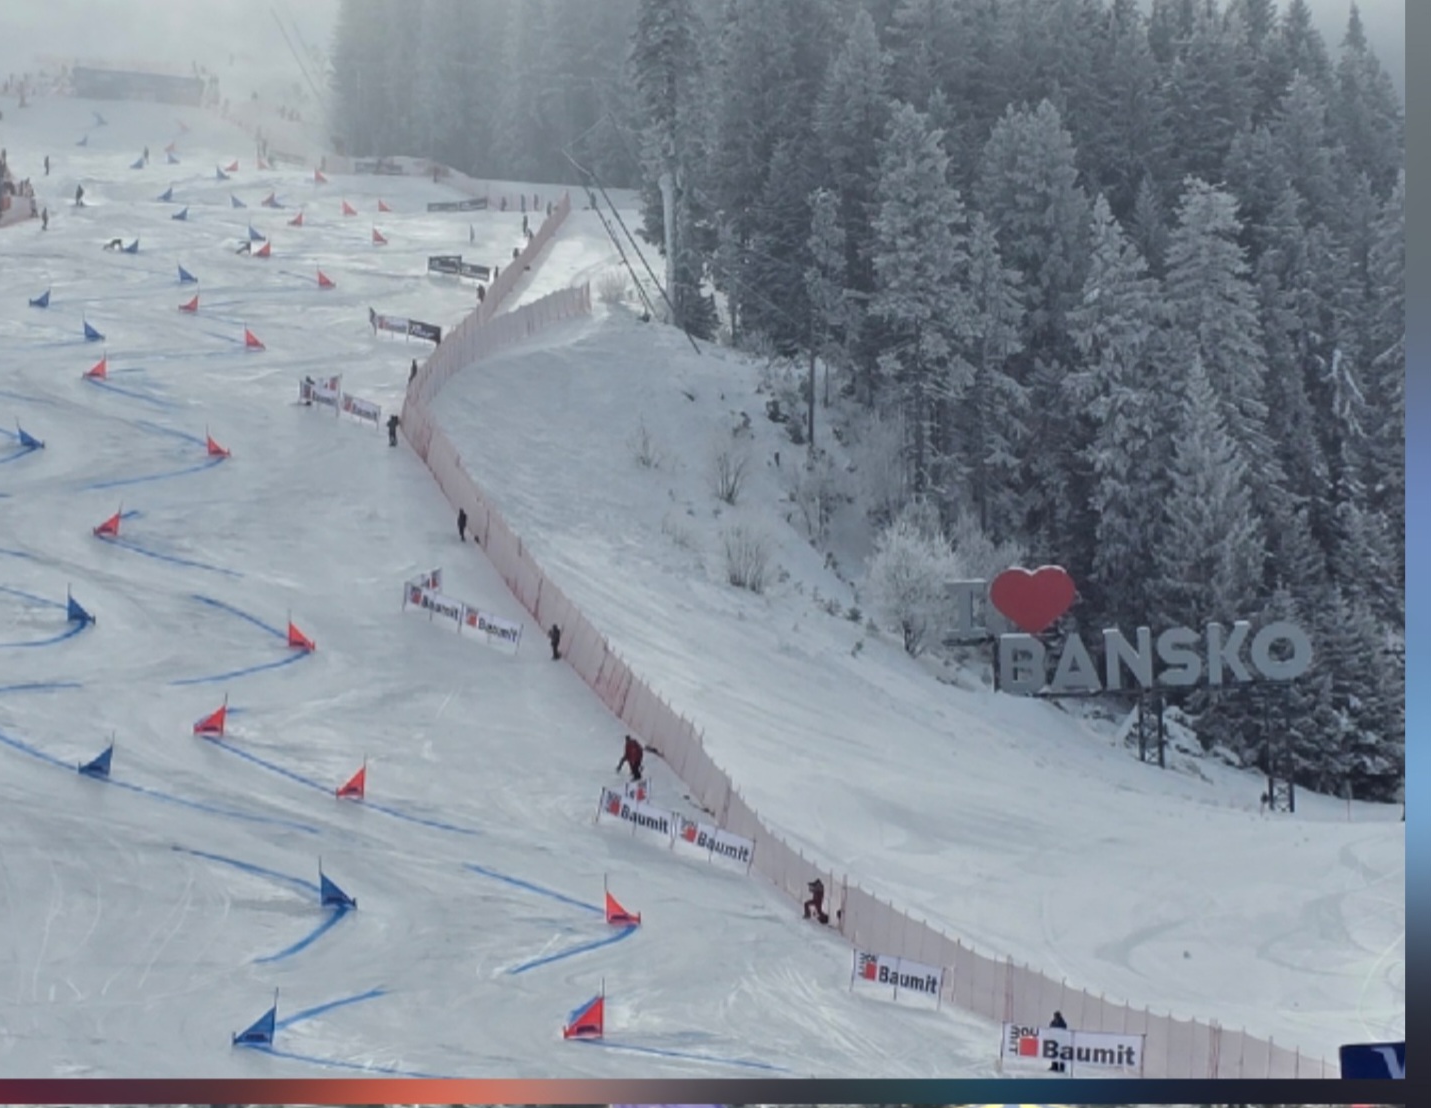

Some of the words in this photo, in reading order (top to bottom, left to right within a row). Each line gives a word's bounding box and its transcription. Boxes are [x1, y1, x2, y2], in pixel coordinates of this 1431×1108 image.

[997, 619, 1314, 694] BANSKO
[620, 803, 669, 834] Baumit
[696, 831, 749, 863] Baumit
[878, 965, 938, 995] Baumit
[1042, 1038, 1136, 1066] Baumit
